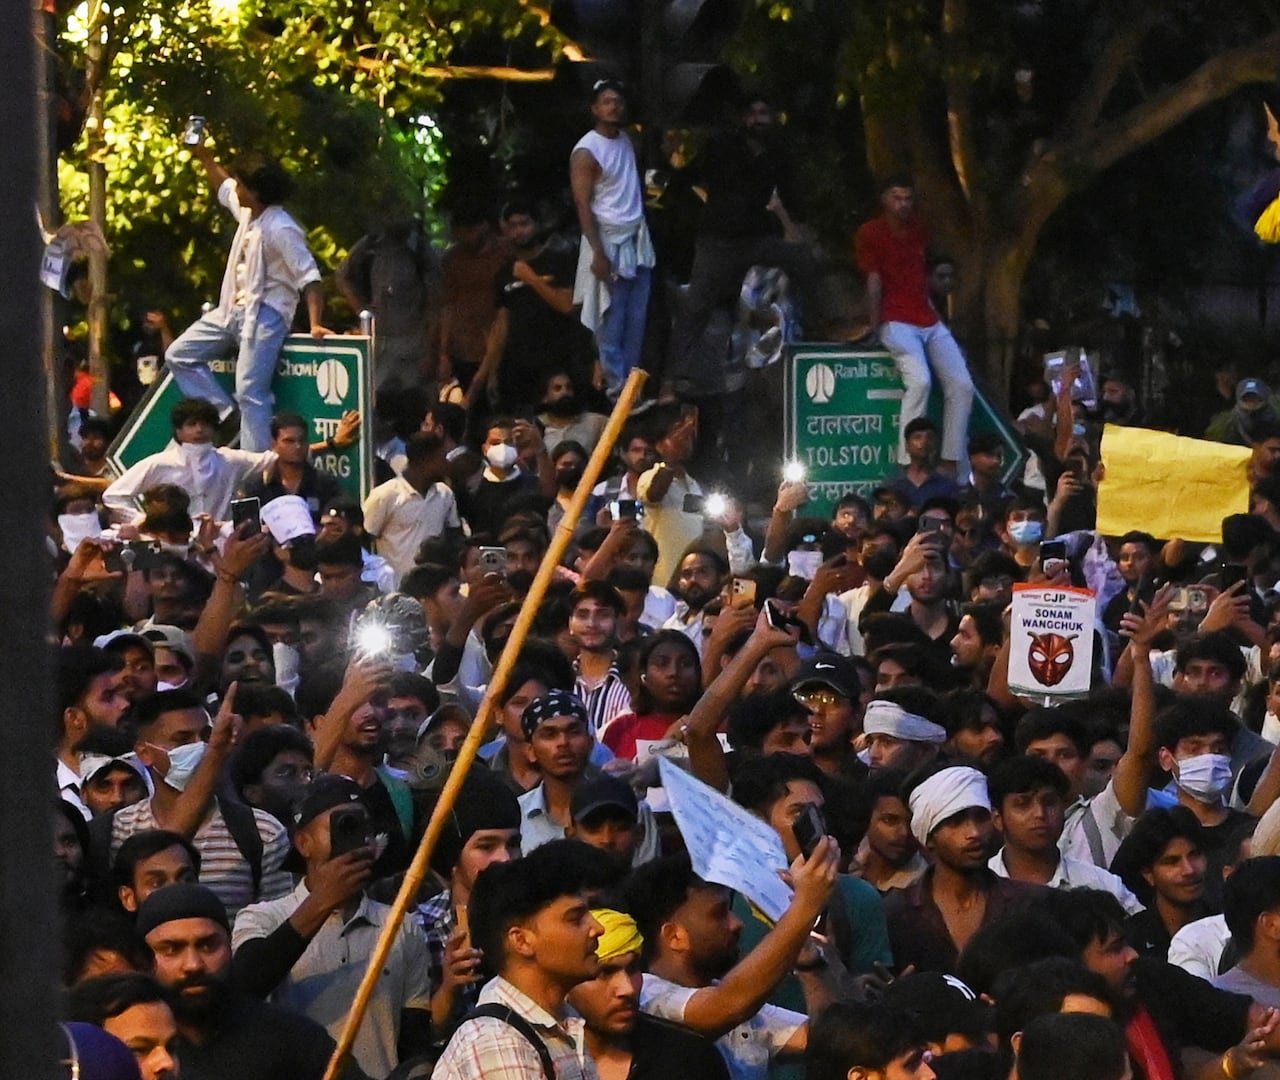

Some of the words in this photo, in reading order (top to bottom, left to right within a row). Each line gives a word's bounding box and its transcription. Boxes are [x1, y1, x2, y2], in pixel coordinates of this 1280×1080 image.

[806, 414, 882, 435] टालस्टाय
[806, 445, 881, 466] TOLSTOY
[313, 455, 350, 478] ARG
[1043, 593, 1066, 603] CJP
[1035, 608, 1072, 620] SONAM
[1022, 618, 1084, 631] WANGCHUK
